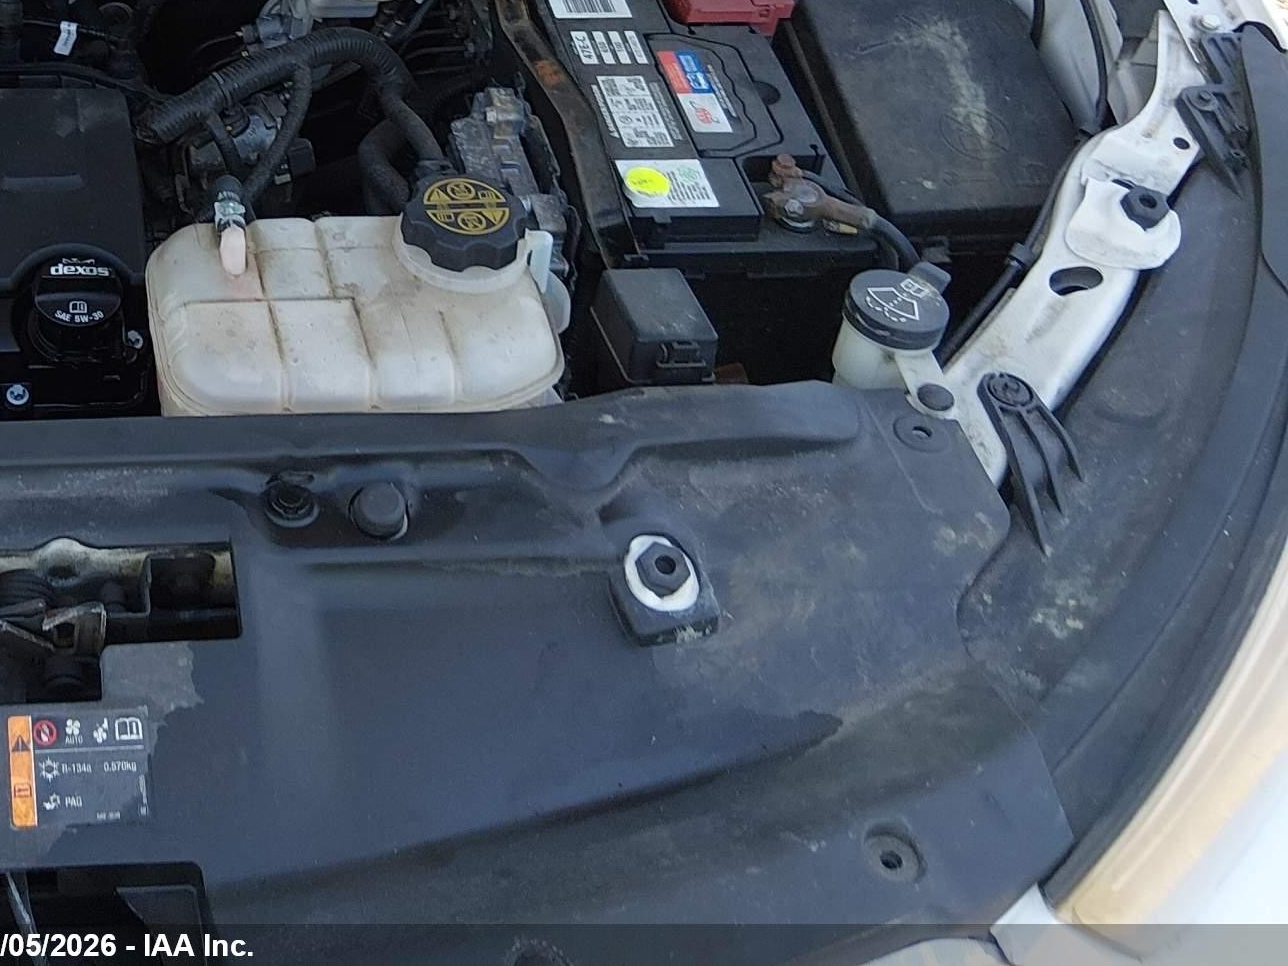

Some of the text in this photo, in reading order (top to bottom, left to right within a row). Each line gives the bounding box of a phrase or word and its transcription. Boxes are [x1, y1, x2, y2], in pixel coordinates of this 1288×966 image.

[50, 265, 110, 276] dexos
[54, 310, 104, 323] SAE 5W-30
[65, 736, 83, 745] AUTO
